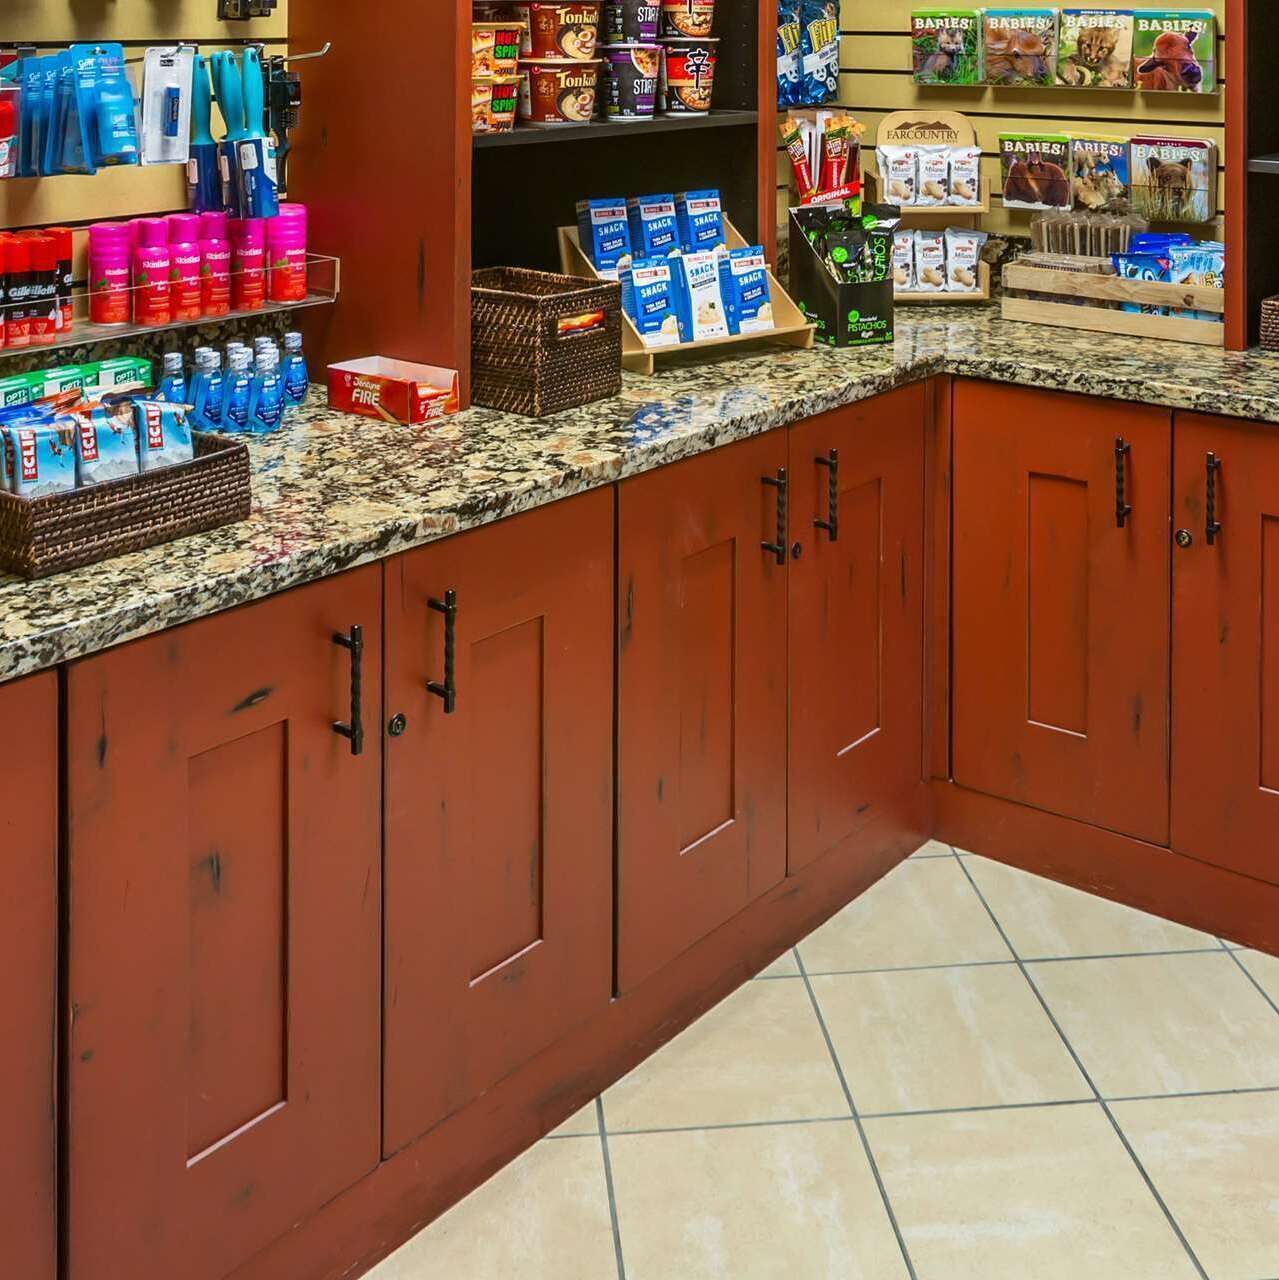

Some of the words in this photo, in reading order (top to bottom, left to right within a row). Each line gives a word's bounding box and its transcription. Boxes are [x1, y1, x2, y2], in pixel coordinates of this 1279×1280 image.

[915, 18, 973, 30] BABIES!
[989, 17, 1053, 30] BABIES!
[1138, 18, 1207, 33] BABIES!
[685, 48, 711, 90] 辛
[887, 129, 960, 140] FARCOUNTRY
[1004, 140, 1065, 156] BABIES!
[1073, 141, 1123, 157] ABIES!
[811, 186, 851, 204] ORIGINAL
[648, 218, 673, 232] SNACK
[694, 213, 719, 227] SNACK
[598, 222, 625, 236] SNACK
[690, 262, 715, 278] SNACK
[738, 270, 764, 287] SNACK
[640, 282, 669, 299] SNACK
[847, 320, 887, 333] PISTACHIOS
[6, 389, 28, 403] OPTI-
[351, 388, 380, 406] FIRE
[424, 405, 444, 418] FIRE
